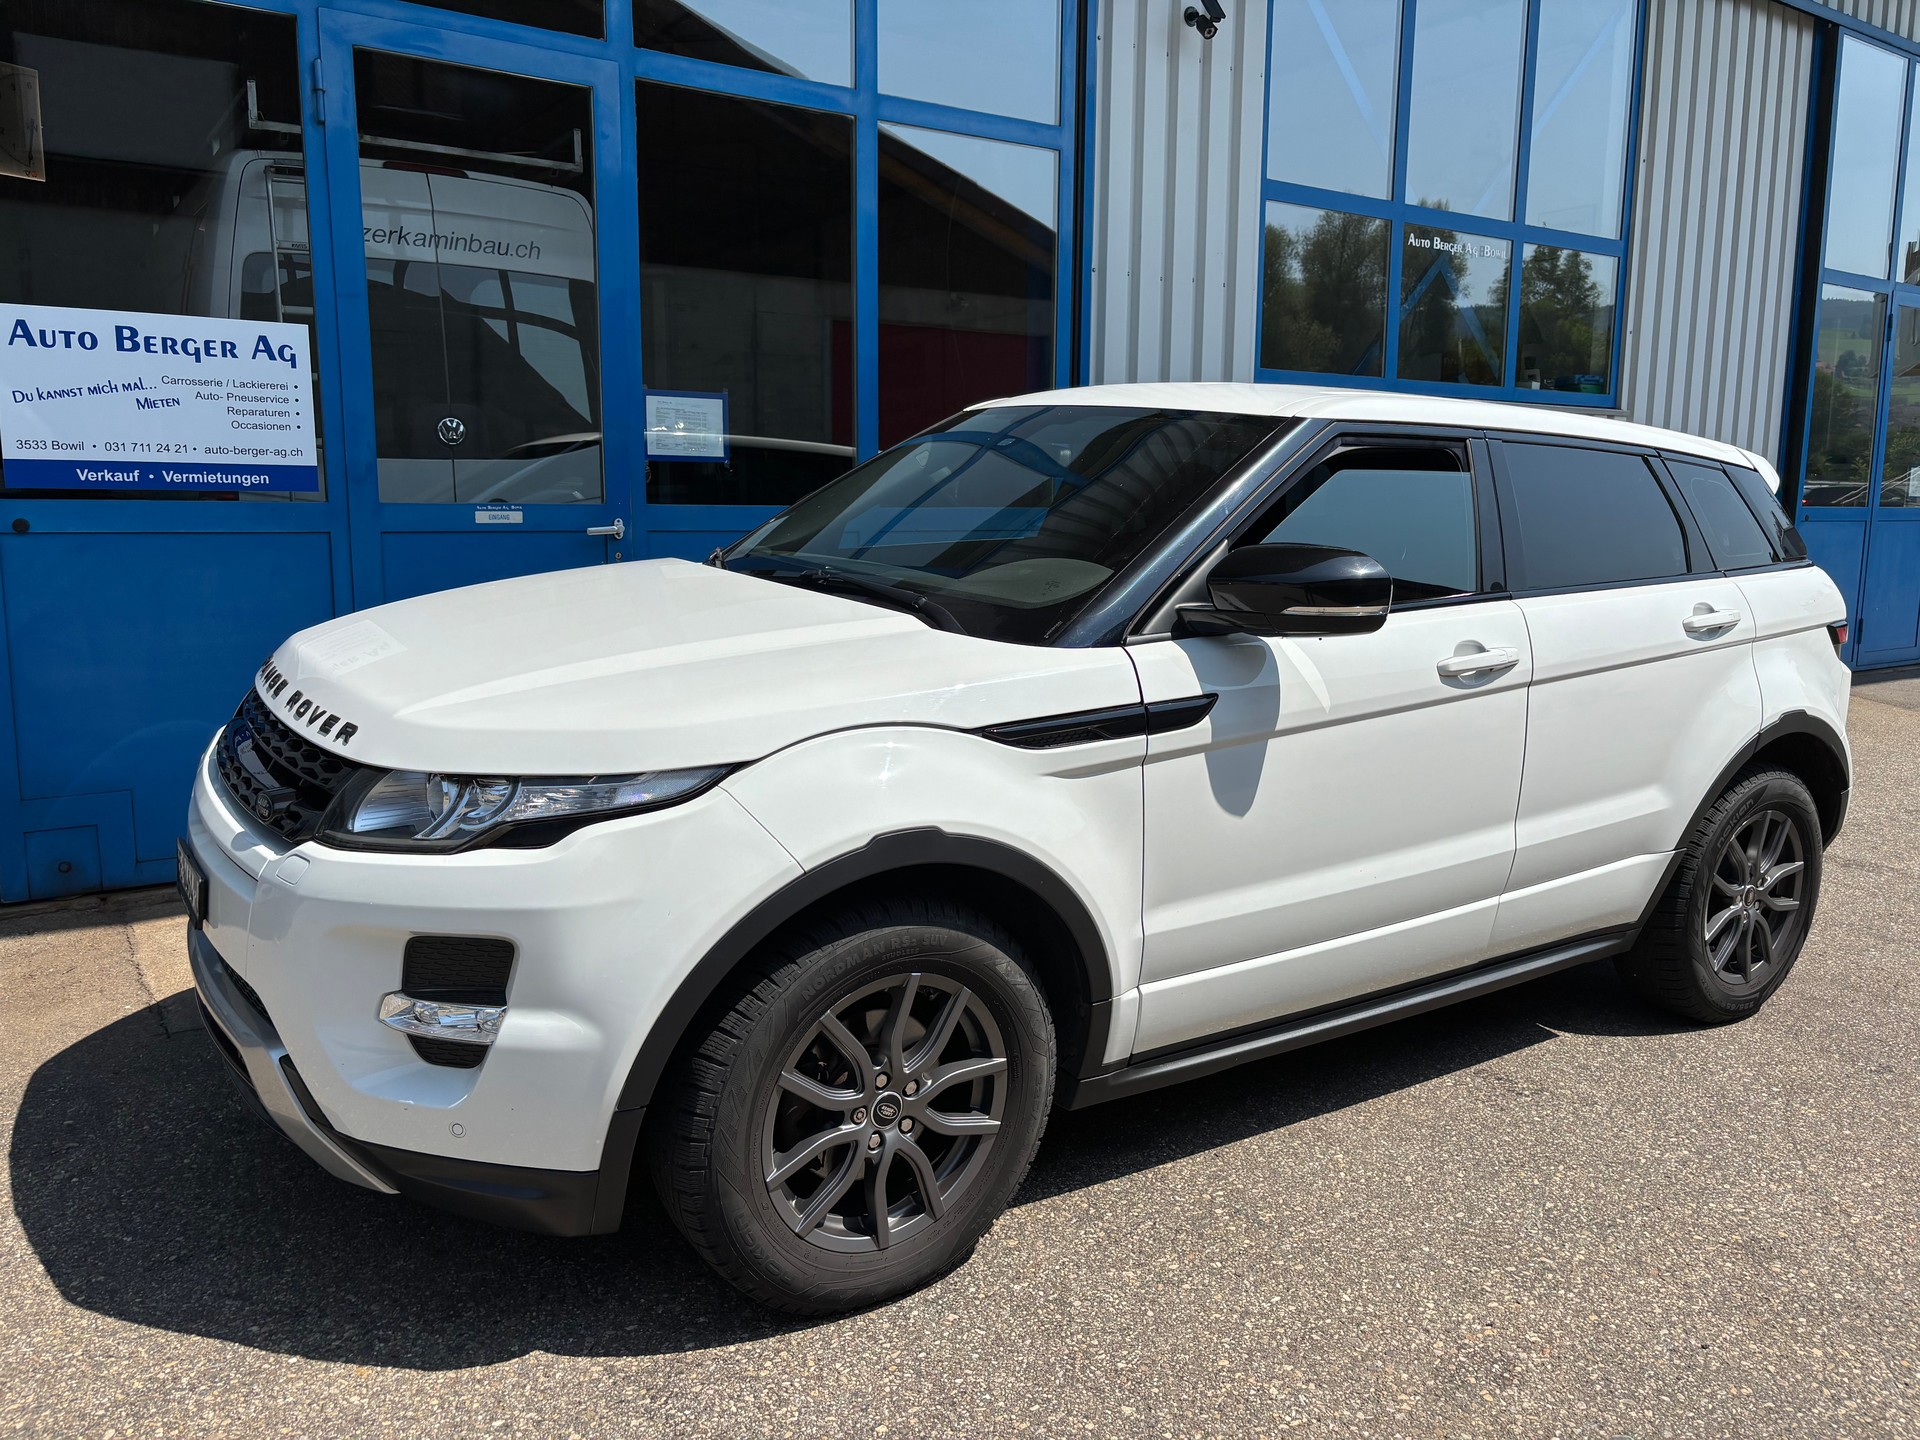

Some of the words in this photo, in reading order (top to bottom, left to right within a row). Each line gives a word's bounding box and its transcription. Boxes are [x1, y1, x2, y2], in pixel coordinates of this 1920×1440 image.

[363, 226, 541, 260] zerkaminbau.ch
[1408, 233, 1430, 248] AUTO
[1433, 237, 1462, 255] BERGER
[8, 318, 98, 350] AUTO
[114, 325, 239, 363] BERGER
[251, 335, 297, 369] AG
[161, 375, 223, 388] Carrosserie
[232, 379, 289, 391] Lackiererei
[195, 391, 223, 401] Auto-
[226, 393, 289, 404] Pneuservice
[227, 406, 290, 418] Reparaturen
[231, 420, 291, 431] Occasionen
[16, 439, 48, 450] 3533
[51, 440, 85, 451] Bowil
[104, 442, 126, 452] 031
[131, 442, 151, 453] 711
[156, 443, 171, 453] 24
[174, 444, 188, 453] 21
[204, 446, 303, 458] auto-berger-ag.ch
[76, 468, 140, 482] Verkauf
[162, 470, 269, 486] Vermietungen
[284, 690, 359, 747] ROVER
[801, 941, 886, 1001] NORDMAN
[923, 934, 949, 947] SUV
